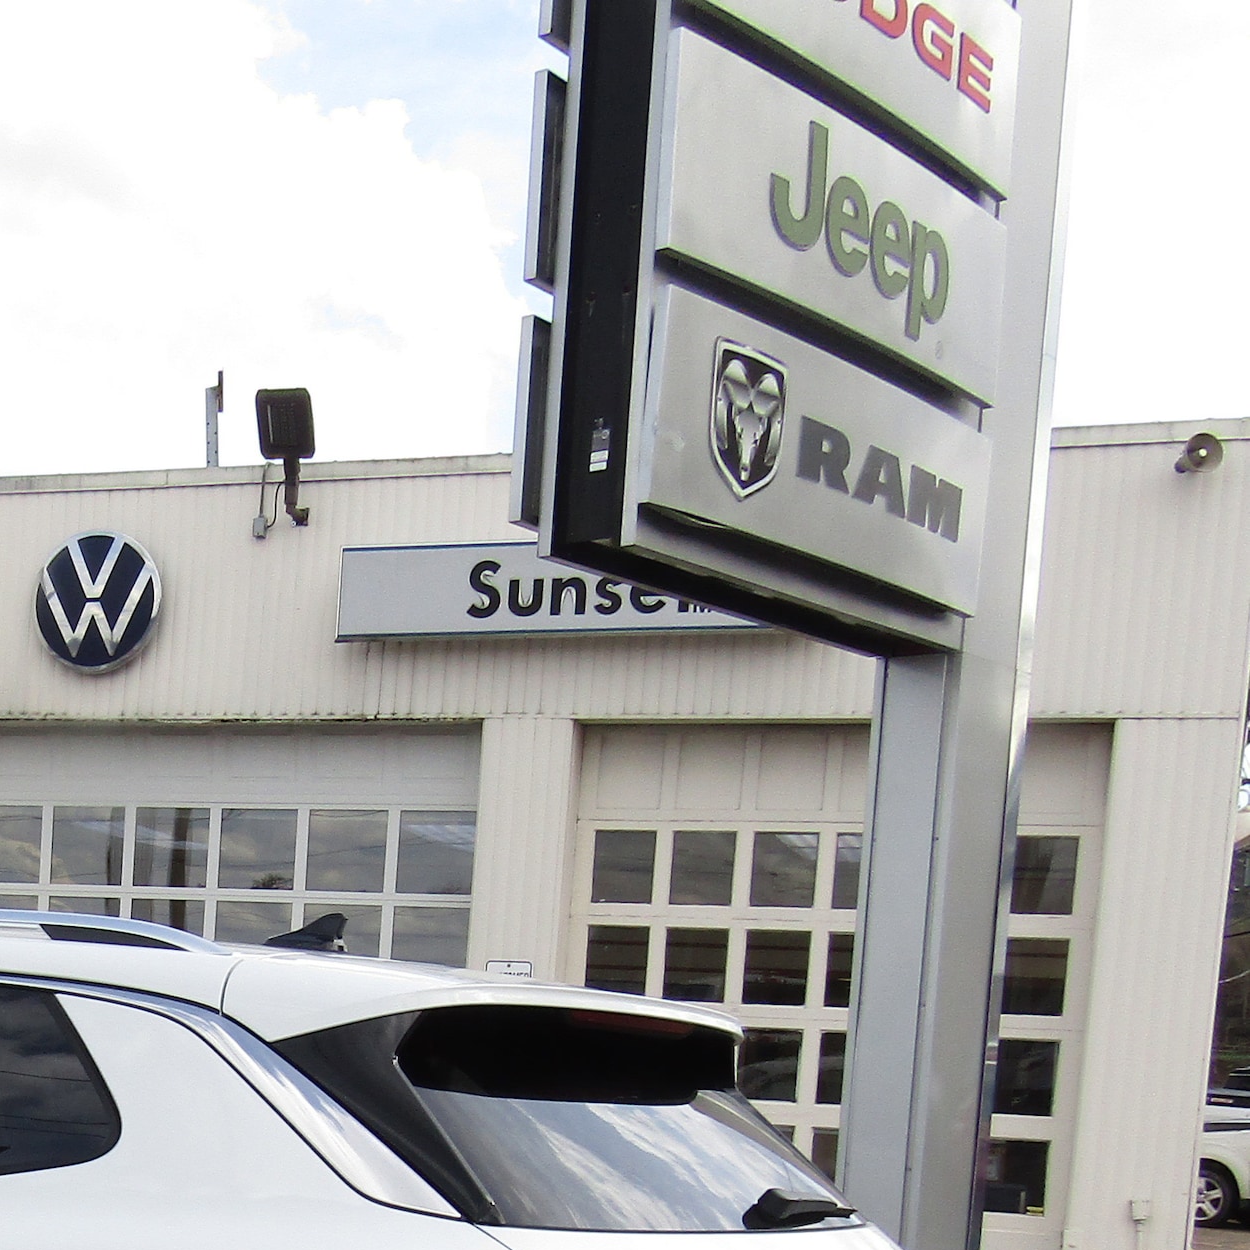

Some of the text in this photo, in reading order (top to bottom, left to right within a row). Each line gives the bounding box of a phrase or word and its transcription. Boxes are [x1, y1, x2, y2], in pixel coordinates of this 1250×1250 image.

[834, 0, 994, 114] DGE
[769, 119, 950, 342] Jeep
[796, 414, 964, 544] RAM
[466, 560, 689, 618] Sunse
